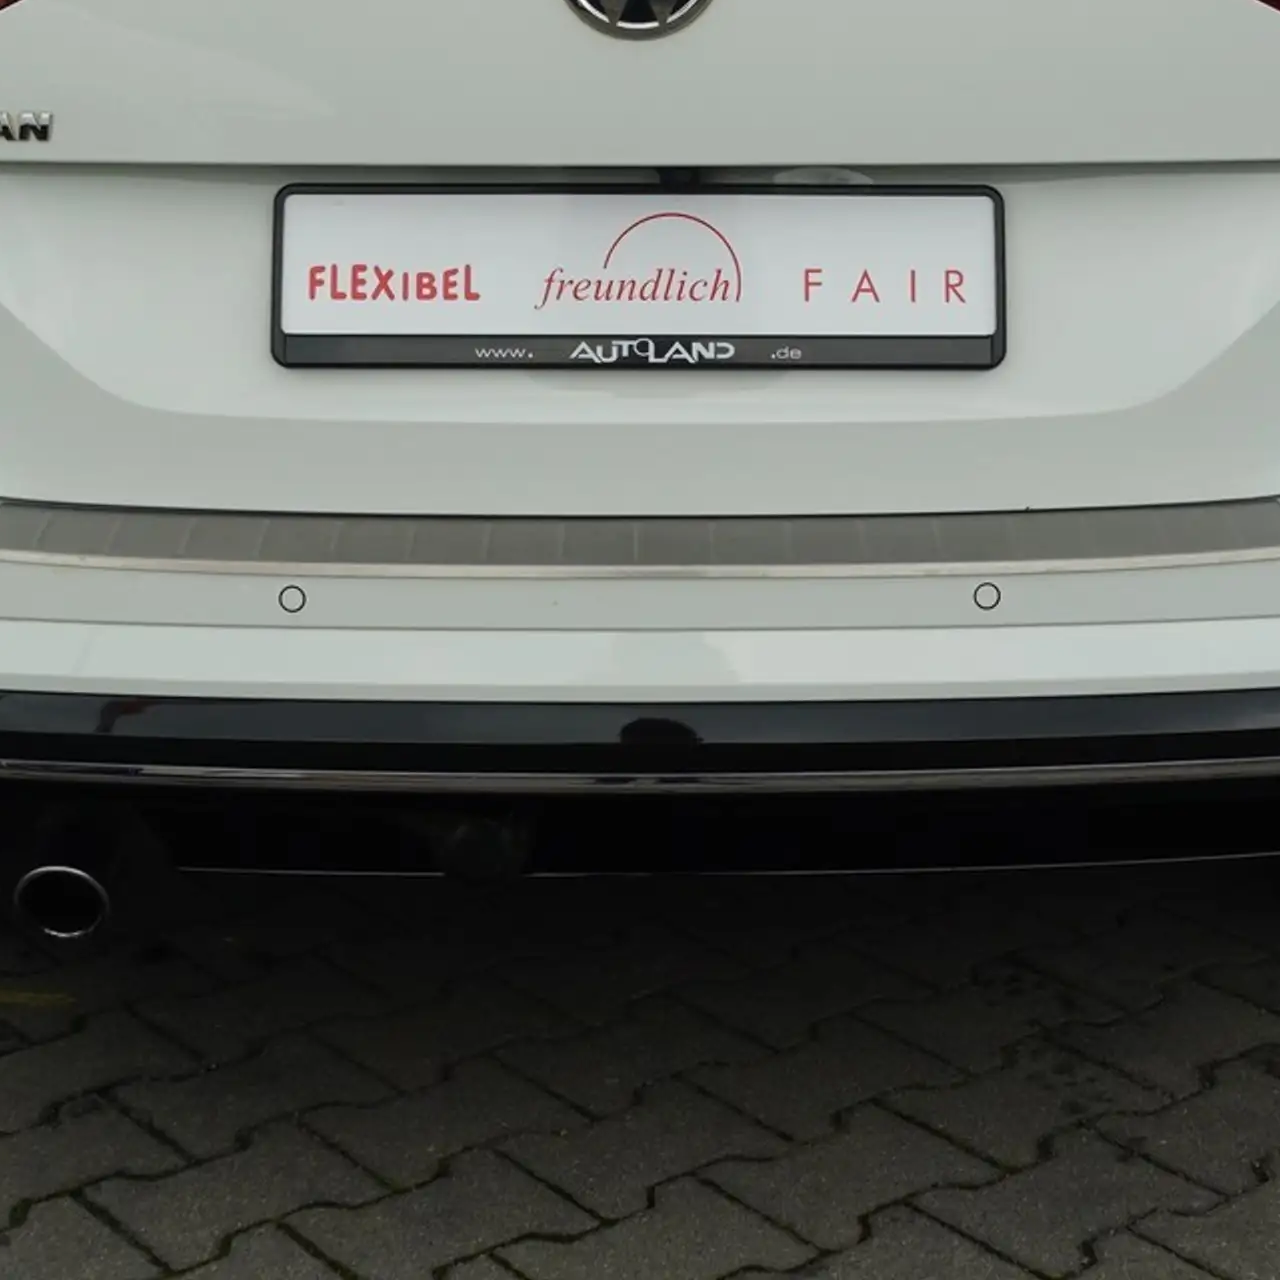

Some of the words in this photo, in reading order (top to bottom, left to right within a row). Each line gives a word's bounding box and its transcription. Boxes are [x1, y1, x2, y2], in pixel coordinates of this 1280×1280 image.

[308, 263, 481, 301] FLEXIBEL
[533, 267, 731, 310] freundlich
[475, 346, 535, 360] www.
[569, 337, 736, 365] AUTOLAND
[770, 345, 803, 360] .de
